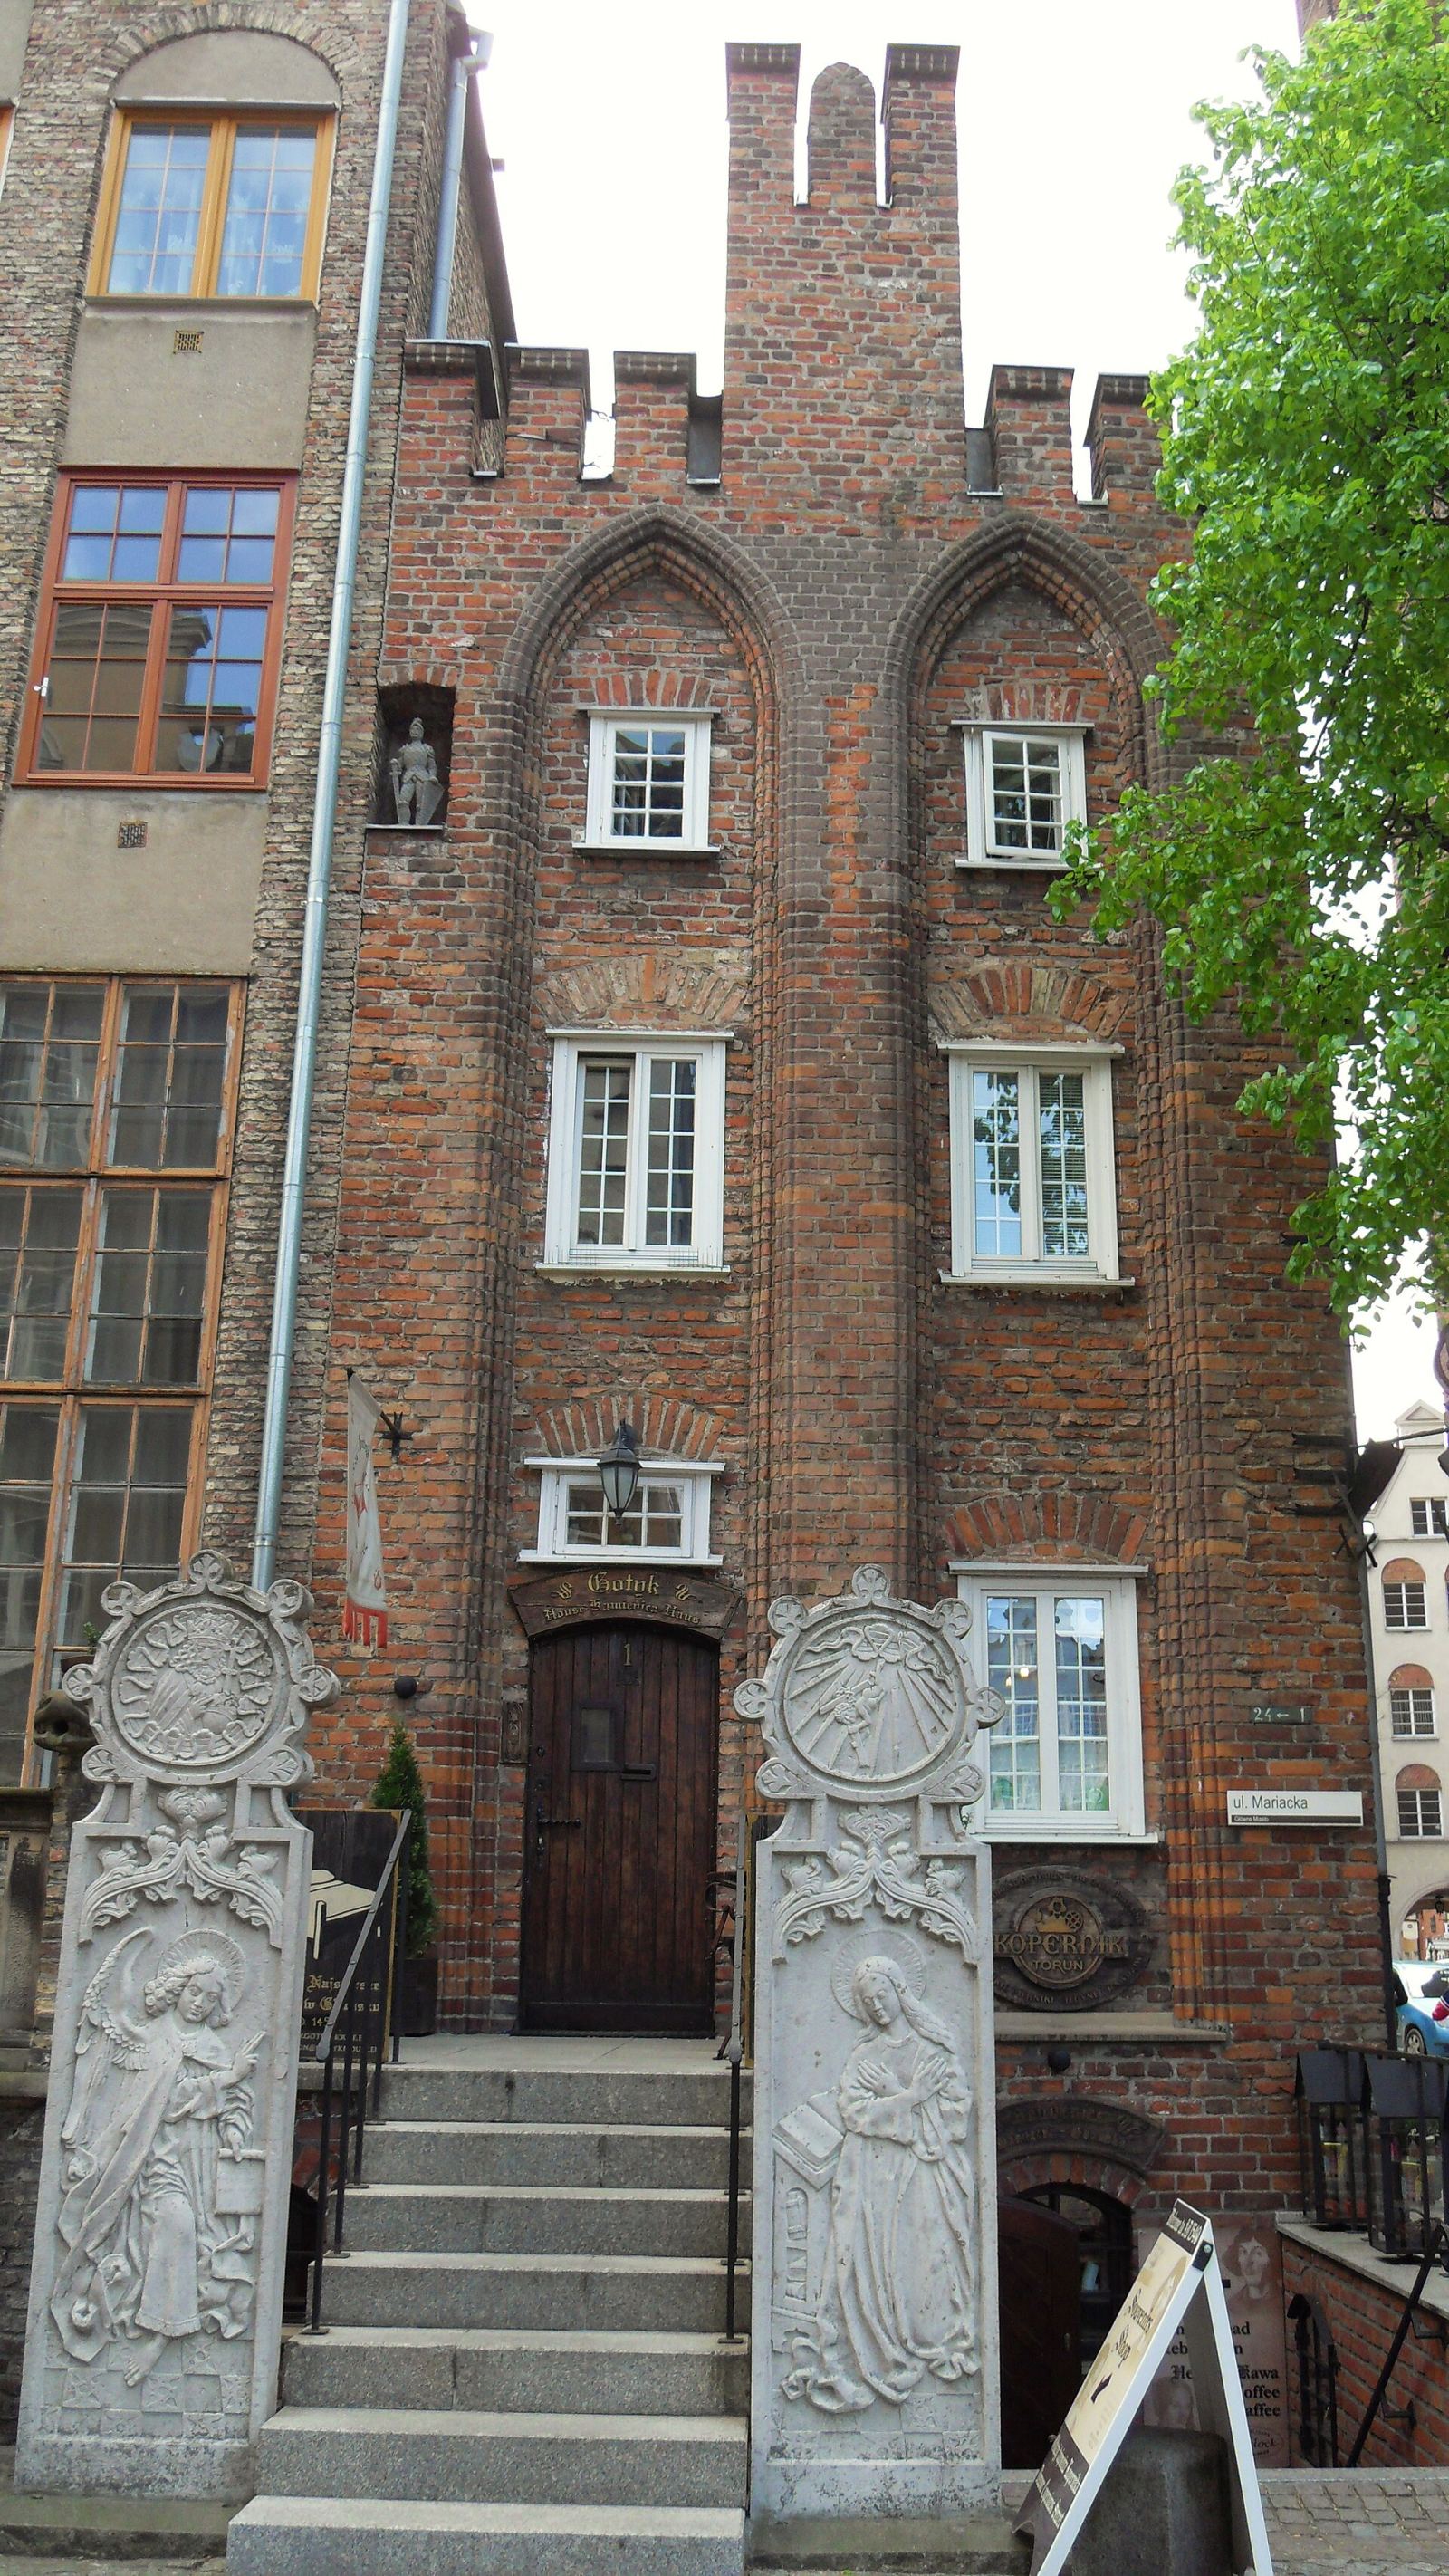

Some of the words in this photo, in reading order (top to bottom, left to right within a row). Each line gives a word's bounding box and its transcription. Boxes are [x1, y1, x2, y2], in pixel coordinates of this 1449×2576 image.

[588, 1572, 659, 1596] Gotyk
[623, 1643, 632, 1667] 1
[1253, 1706, 1271, 1723] 24
[1299, 1706, 1306, 1723] 1
[1233, 1795, 1248, 1809] ul.
[1252, 1795, 1308, 1810] Mariacka
[994, 1933, 1124, 1956] KOPERNIK
[1244, 2385, 1281, 2398] offee
[1246, 2403, 1281, 2417] affee
